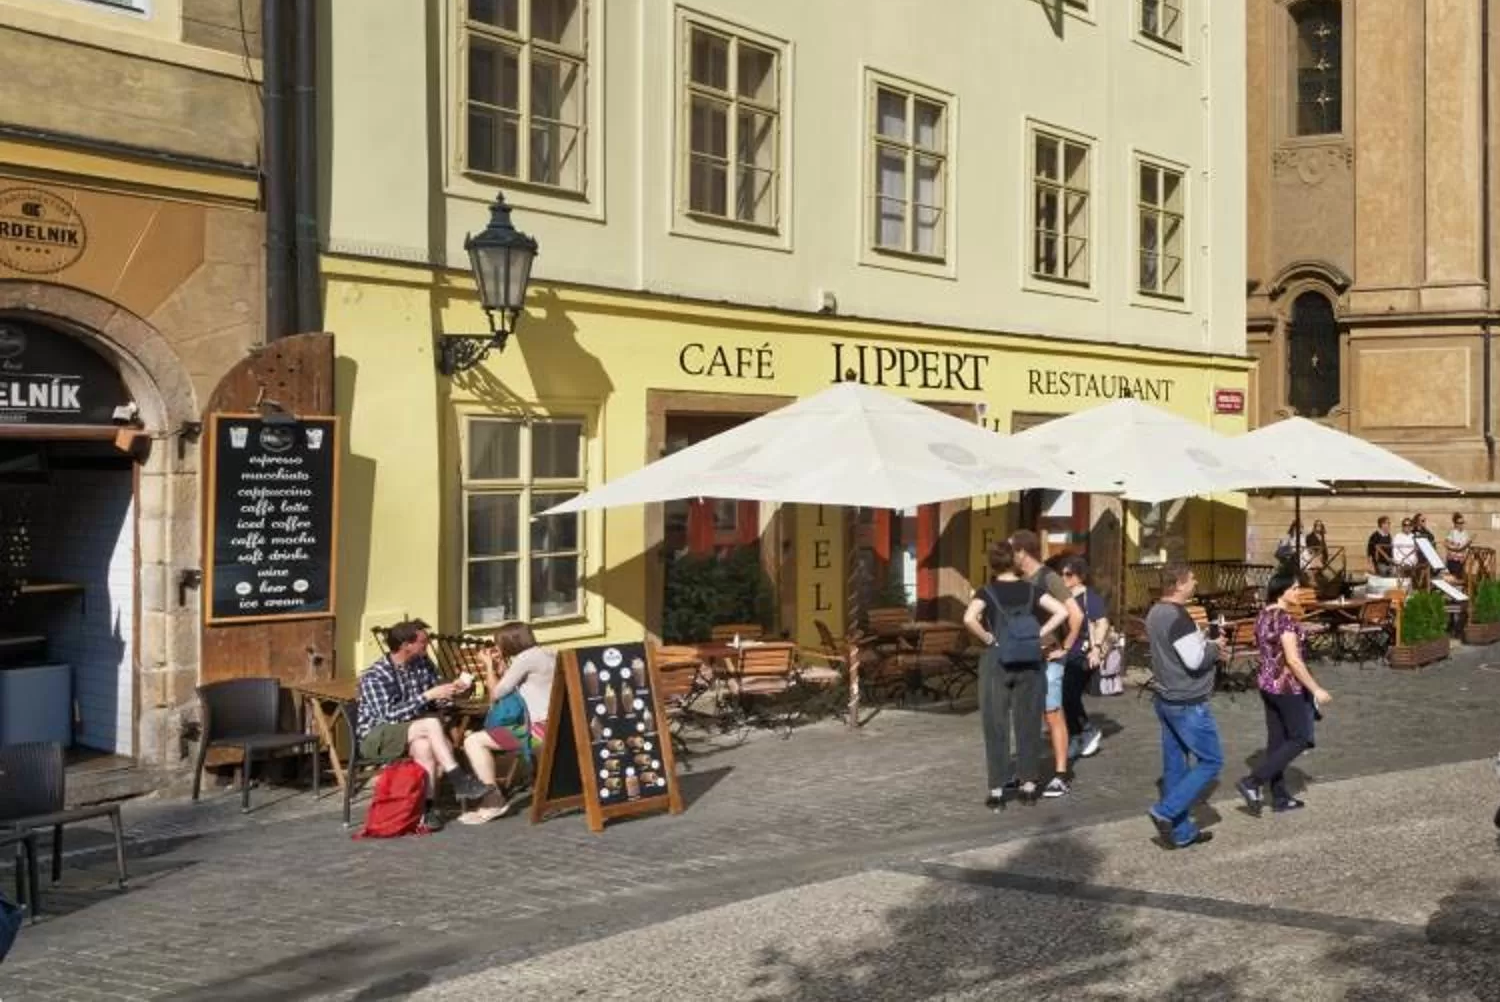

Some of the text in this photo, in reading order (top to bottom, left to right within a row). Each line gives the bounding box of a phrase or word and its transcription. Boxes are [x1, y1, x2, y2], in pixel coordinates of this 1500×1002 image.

[679, 342, 775, 380] CAFÉ
[1028, 369, 1175, 402] RESTAURANT
[249, 454, 303, 467] espresso
[241, 468, 309, 480] macchiato
[237, 486, 312, 500] cappuccino
[280, 500, 309, 512] latte
[237, 516, 311, 532] iced coffee
[271, 532, 316, 544] mocha
[238, 548, 309, 564] soft drinks
[258, 566, 288, 577] wine
[260, 580, 287, 592] beer
[239, 598, 304, 608] ice cream
